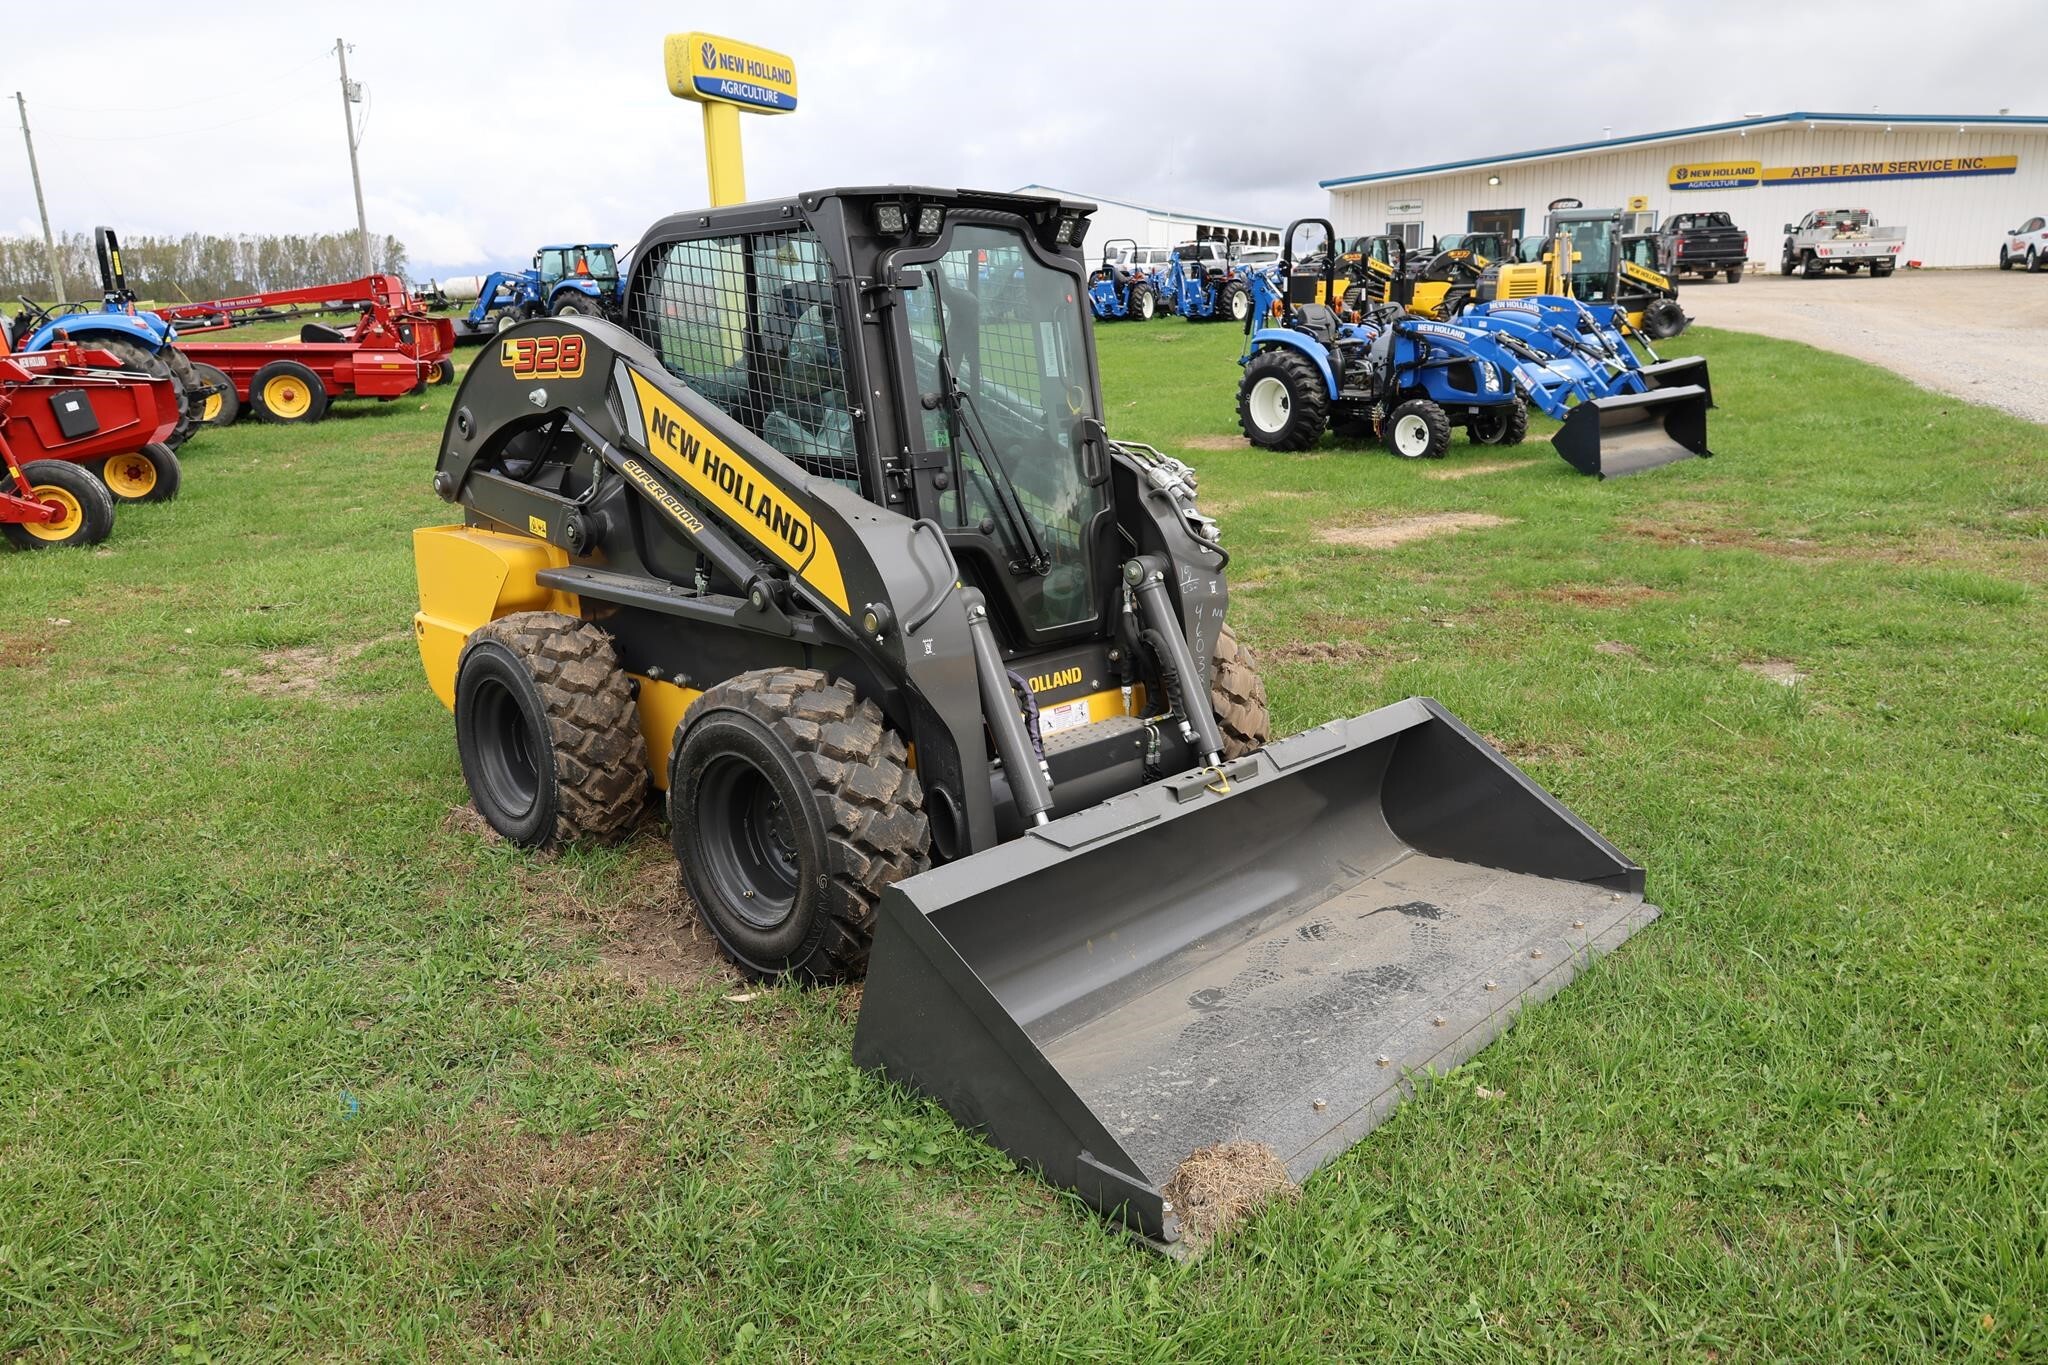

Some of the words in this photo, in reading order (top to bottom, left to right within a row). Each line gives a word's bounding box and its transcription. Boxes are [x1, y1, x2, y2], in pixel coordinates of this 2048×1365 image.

[719, 52, 745, 73] NEW
[747, 60, 792, 85] HOLLAND
[720, 79, 779, 104] AGRICULTURE
[1690, 169, 1711, 178] NEW
[1713, 167, 1755, 177] HOLLAND
[1791, 164, 1838, 178] APPLE
[1842, 162, 1883, 175] FARM
[1888, 159, 1953, 173] SERVICE
[1957, 157, 1987, 170] INC.
[1688, 180, 1739, 189] AGRICULTURE
[1489, 301, 1506, 310] NEW
[1506, 301, 1540, 313] HOLLAND
[1417, 323, 1435, 333] NEW
[1434, 326, 1466, 340] HOLLAND
[501, 335, 585, 379] L328
[651, 406, 701, 465] NEW
[702, 447, 808, 553] HOLLAND
[623, 460, 667, 500] SUPER
[661, 496, 704, 533] BOOM
[1028, 666, 1083, 694] OLLAND
